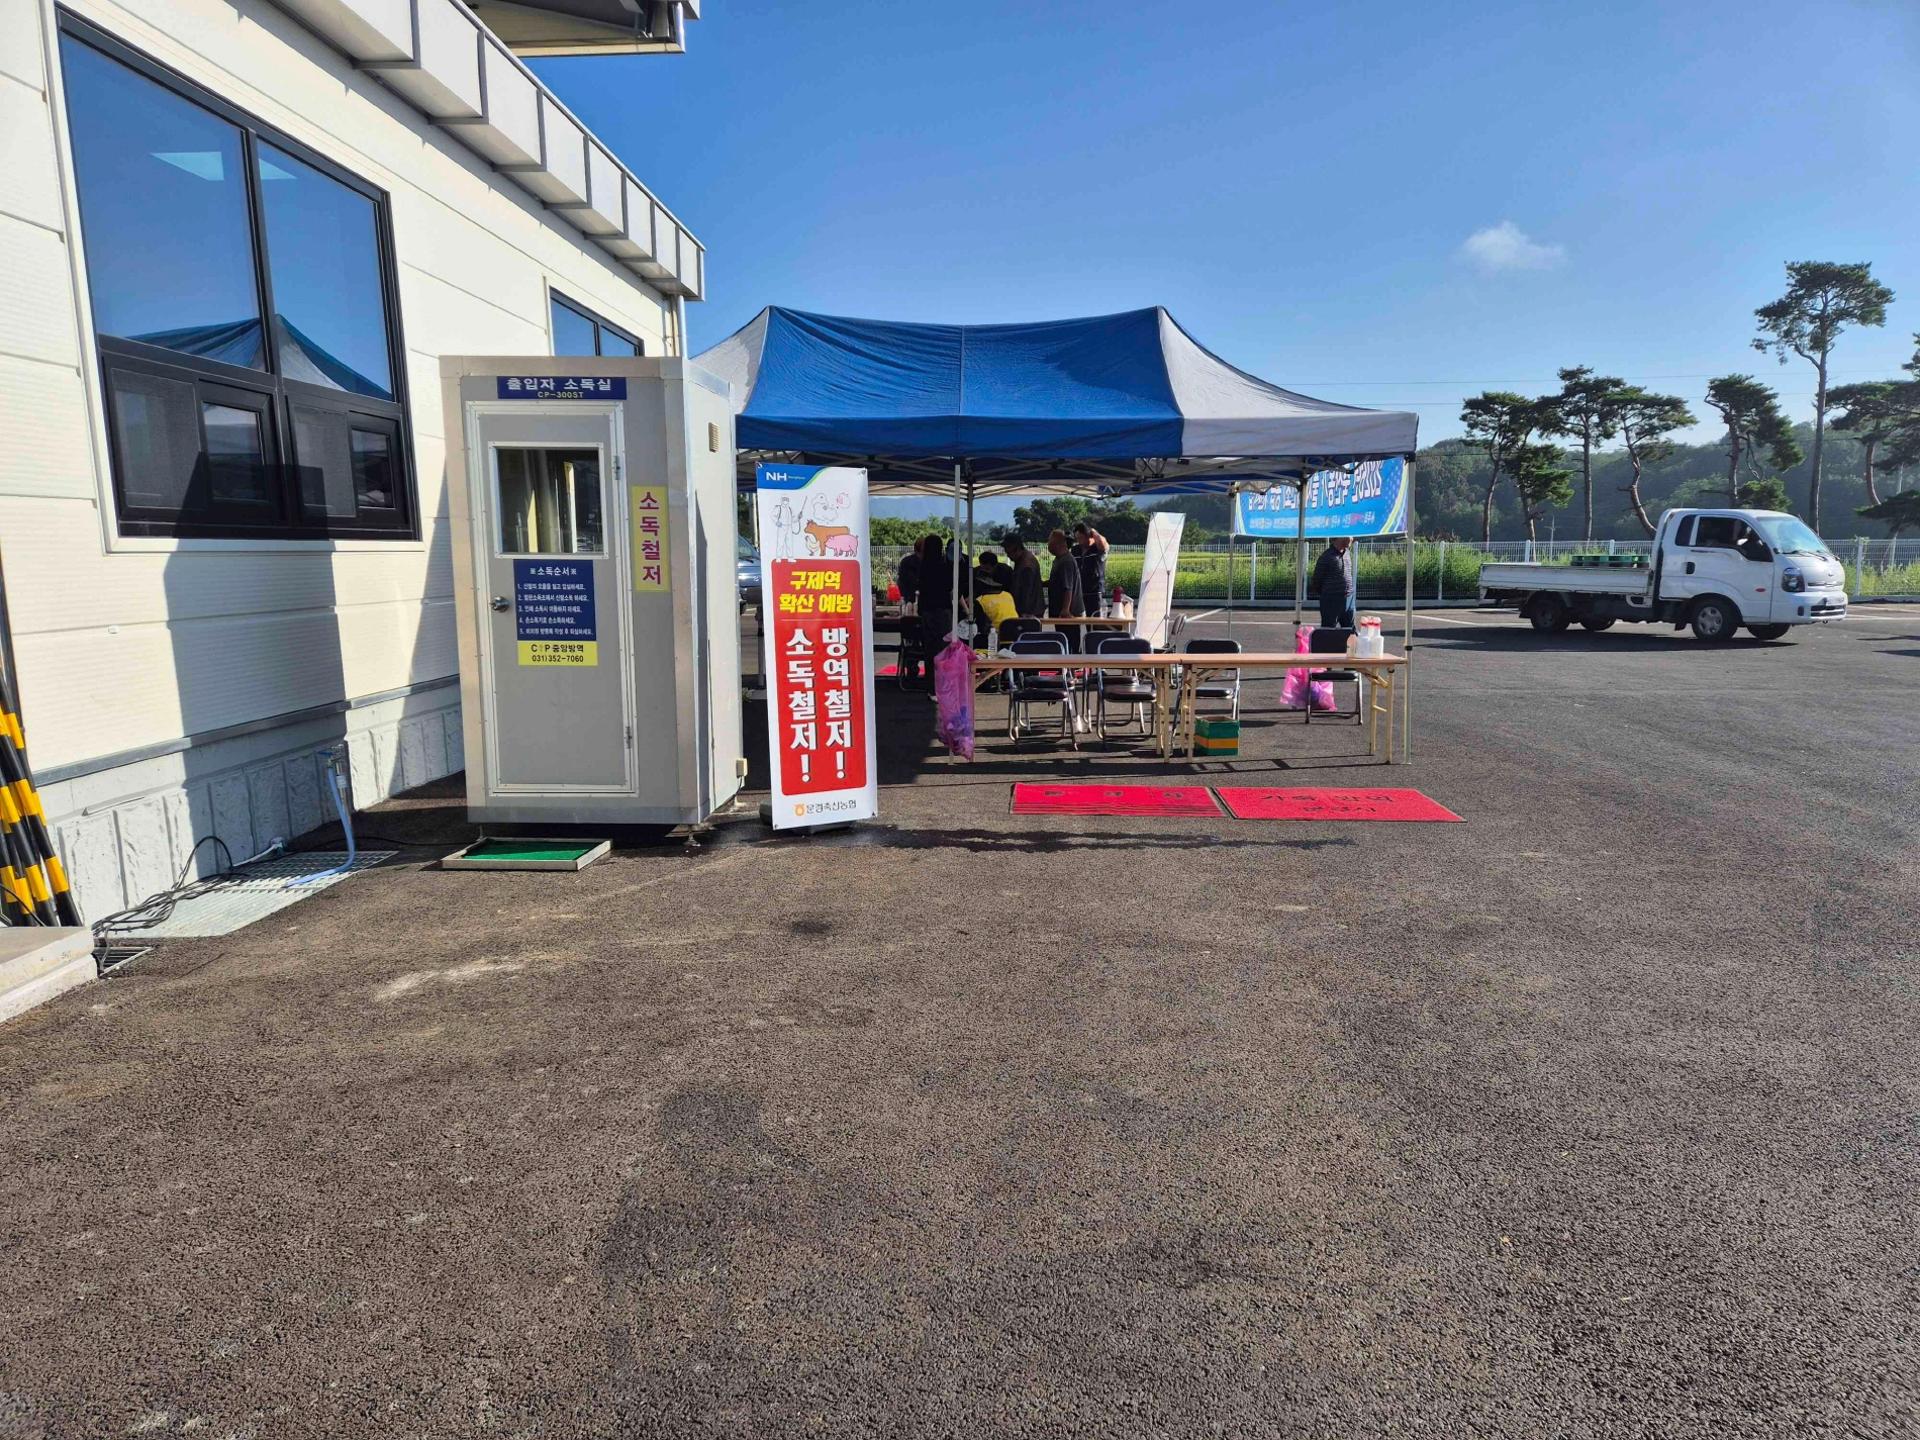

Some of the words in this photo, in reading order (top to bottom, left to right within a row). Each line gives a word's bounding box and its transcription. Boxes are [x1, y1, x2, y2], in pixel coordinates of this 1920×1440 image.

[506, 377, 556, 391] 출입자
[563, 378, 612, 391] 소독실
[537, 391, 584, 399] CP-300ST
[765, 471, 787, 481] NH
[639, 491, 662, 585] 소독철저
[790, 570, 842, 590] 구제역
[779, 593, 815, 613] 확산
[819, 593, 854, 613] 예방
[531, 654, 584, 663] 031)352-7060
[785, 628, 817, 783] 소독철저!
[821, 627, 851, 780] 방역철저!
